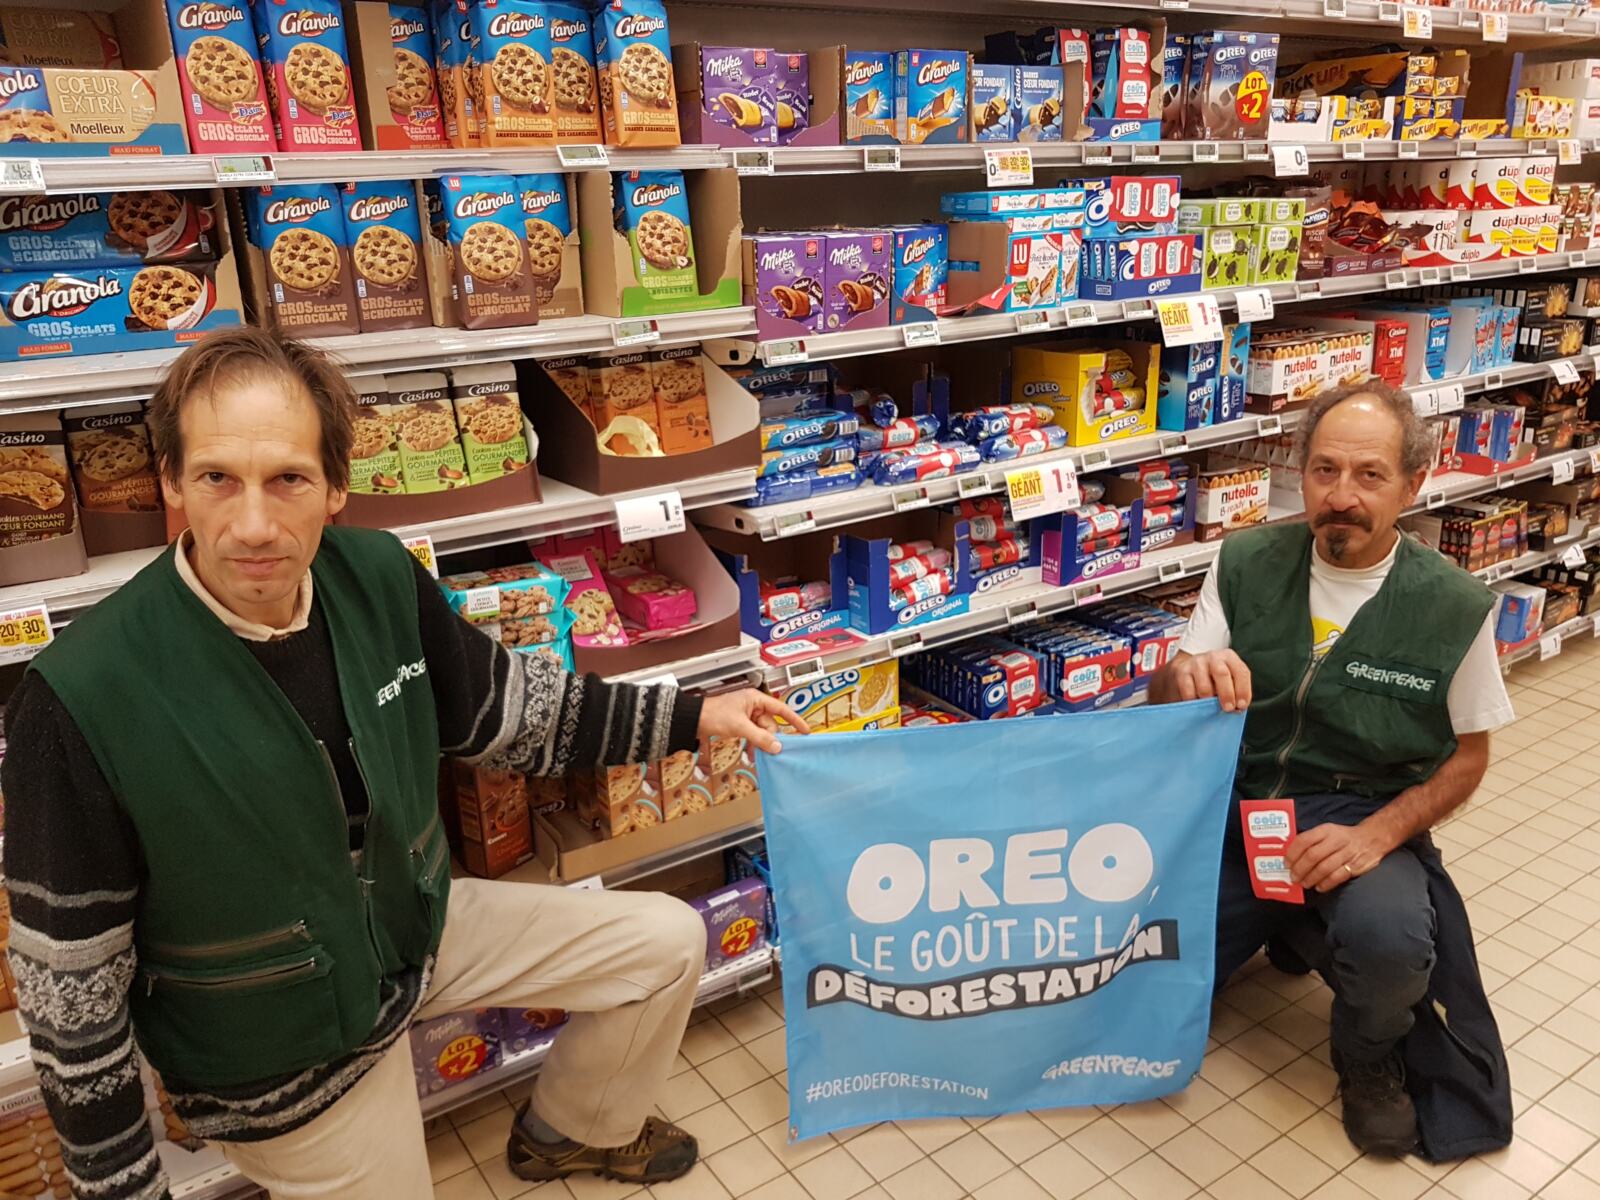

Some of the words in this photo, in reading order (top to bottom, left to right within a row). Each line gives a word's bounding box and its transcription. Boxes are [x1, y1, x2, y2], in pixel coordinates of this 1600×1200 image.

[180, 3, 244, 30] Granola
[280, 12, 340, 36] Granola
[490, 13, 545, 37] Granola
[550, 20, 586, 38] ranola
[615, 15, 664, 38] Granola
[1165, 48, 1182, 59] REO
[1215, 46, 1246, 63] OREO
[1250, 48, 1277, 64] OREO
[706, 55, 743, 76] Milka
[918, 59, 961, 84] Granola
[983, 78, 1005, 87] FONDANT
[1039, 80, 1059, 88] FONDANT
[1245, 78, 1263, 89] LOT
[59, 95, 125, 113] EXTRA
[70, 123, 125, 135] Moelleux
[199, 123, 234, 141] GROS
[293, 127, 326, 144] GROS
[1110, 121, 1141, 139] OREO
[990, 164, 996, 176] 0
[451, 180, 460, 188] LU
[455, 192, 514, 217] Granola
[523, 190, 561, 211] ranola
[632, 185, 680, 206] Granola
[266, 198, 330, 223] Granola
[350, 196, 408, 221] Granola
[9, 236, 52, 250] GROS
[903, 236, 935, 264] Granola
[22, 250, 97, 262] CHOCOLAT
[761, 249, 796, 270] Milka
[830, 244, 862, 265] Milka
[1014, 244, 1027, 264] LU
[1461, 250, 1480, 260] duplo
[643, 276, 667, 287] GROS
[12, 276, 120, 318] Granola
[360, 296, 392, 310] GROS
[468, 294, 499, 306] GROS
[279, 301, 313, 315] GROS
[370, 306, 423, 320] CHOCOLAT
[477, 303, 531, 316] CHOCOLAT
[1162, 308, 1191, 326] GÉANT
[1197, 303, 1208, 325] 1
[289, 311, 347, 326] CHOCOLAT
[28, 321, 72, 338] GROS
[609, 353, 643, 367] Casino
[660, 348, 693, 360] Casino
[1330, 350, 1362, 368] nutella
[542, 358, 576, 369] Casino
[1284, 358, 1317, 375] nutella
[399, 390, 441, 404] Casino
[468, 383, 510, 396] Casino
[1024, 383, 1060, 396] OREO
[1189, 386, 1212, 402] OREO
[82, 414, 132, 430] Casino
[1100, 415, 1138, 438] OREO
[782, 424, 821, 445] OREO
[407, 457, 463, 470] GOURMANDES
[472, 450, 526, 461] GOURMANDES
[778, 451, 817, 472] OREO
[1011, 478, 1041, 498] GÉANT
[1052, 469, 1063, 492] 1
[1221, 484, 1258, 503] nutella
[21, 513, 65, 521] GOURMAND
[659, 500, 670, 521] 1
[23, 520, 65, 529] FONDANT
[1082, 551, 1122, 578] OREO
[977, 566, 1019, 592] OREO
[898, 594, 946, 624] OREO
[932, 600, 963, 618] ORIGINAL
[771, 610, 823, 641] OREO
[807, 614, 842, 633] ORIGINAL
[1346, 661, 1435, 692] GREENPEACE
[786, 668, 860, 713] OREO
[728, 920, 752, 935] LOT
[850, 932, 895, 972] LE
[911, 911, 1019, 973] GOÛT
[1034, 915, 1079, 959] DE
[1094, 913, 1140, 953] LA
[815, 925, 1163, 1016] DÉFORESTATION
[425, 1017, 462, 1042] Milka
[447, 1039, 474, 1055] LOT
[1041, 1055, 1181, 1080] GREENPEACE
[806, 1072, 989, 1103] #OREODEFORESTATION
